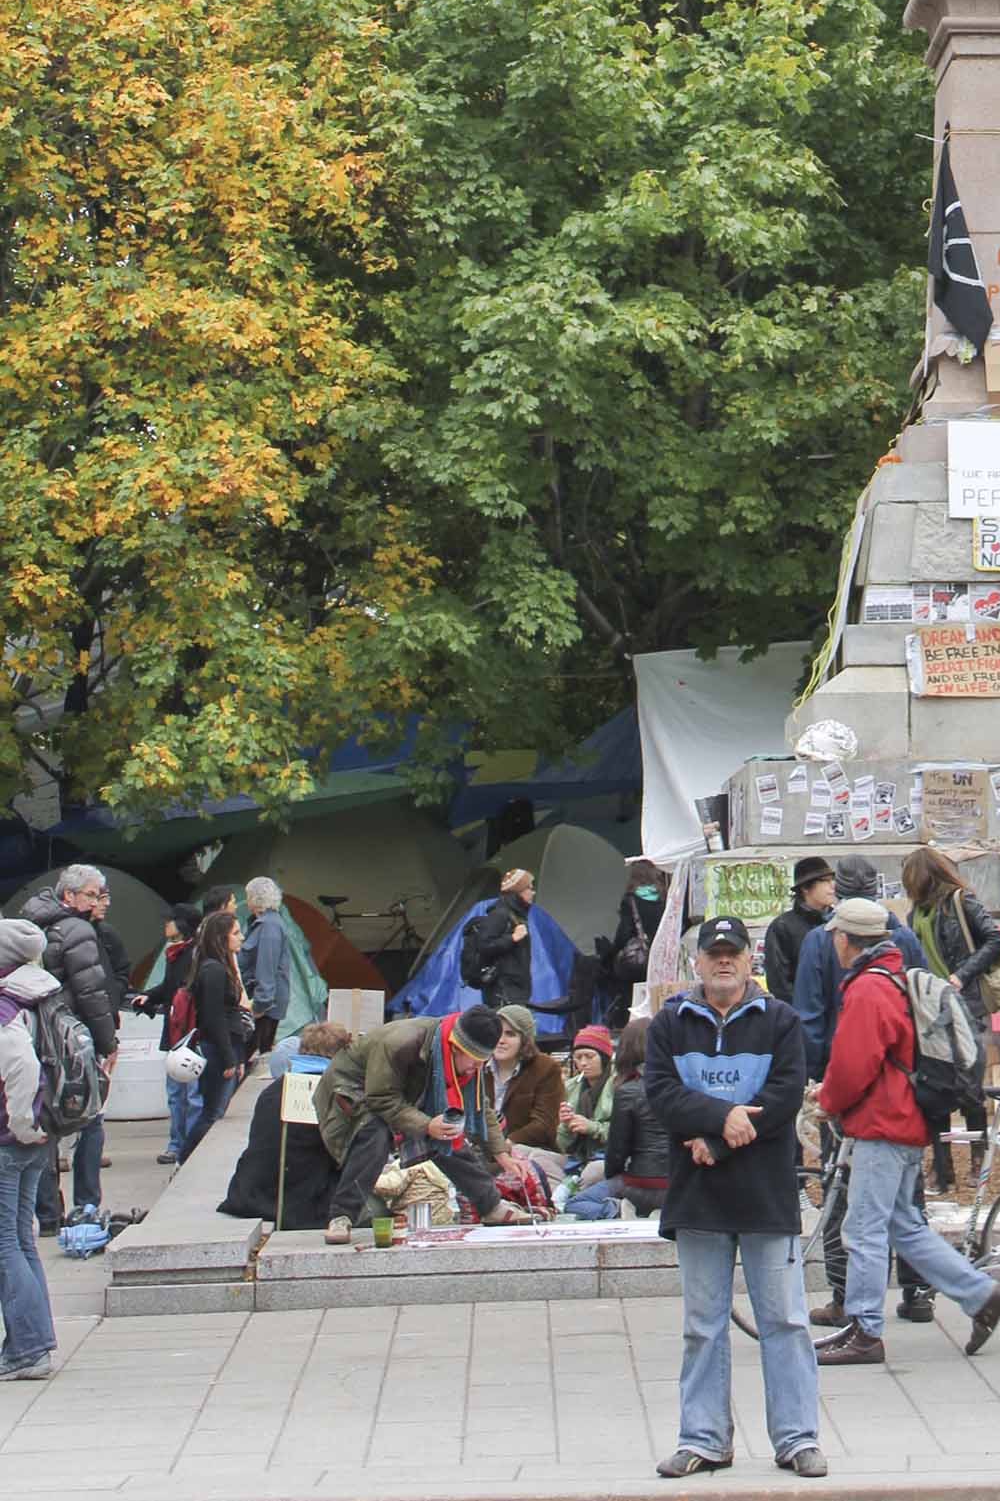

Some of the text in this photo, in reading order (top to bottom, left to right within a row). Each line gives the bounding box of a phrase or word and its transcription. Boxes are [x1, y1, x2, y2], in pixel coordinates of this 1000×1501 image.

[924, 648, 942, 662] BE
[945, 646, 979, 660] FREE
[926, 674, 952, 685] AND
[953, 673, 968, 683] BE
[935, 684, 953, 694] IN
[956, 681, 988, 693] LIFE
